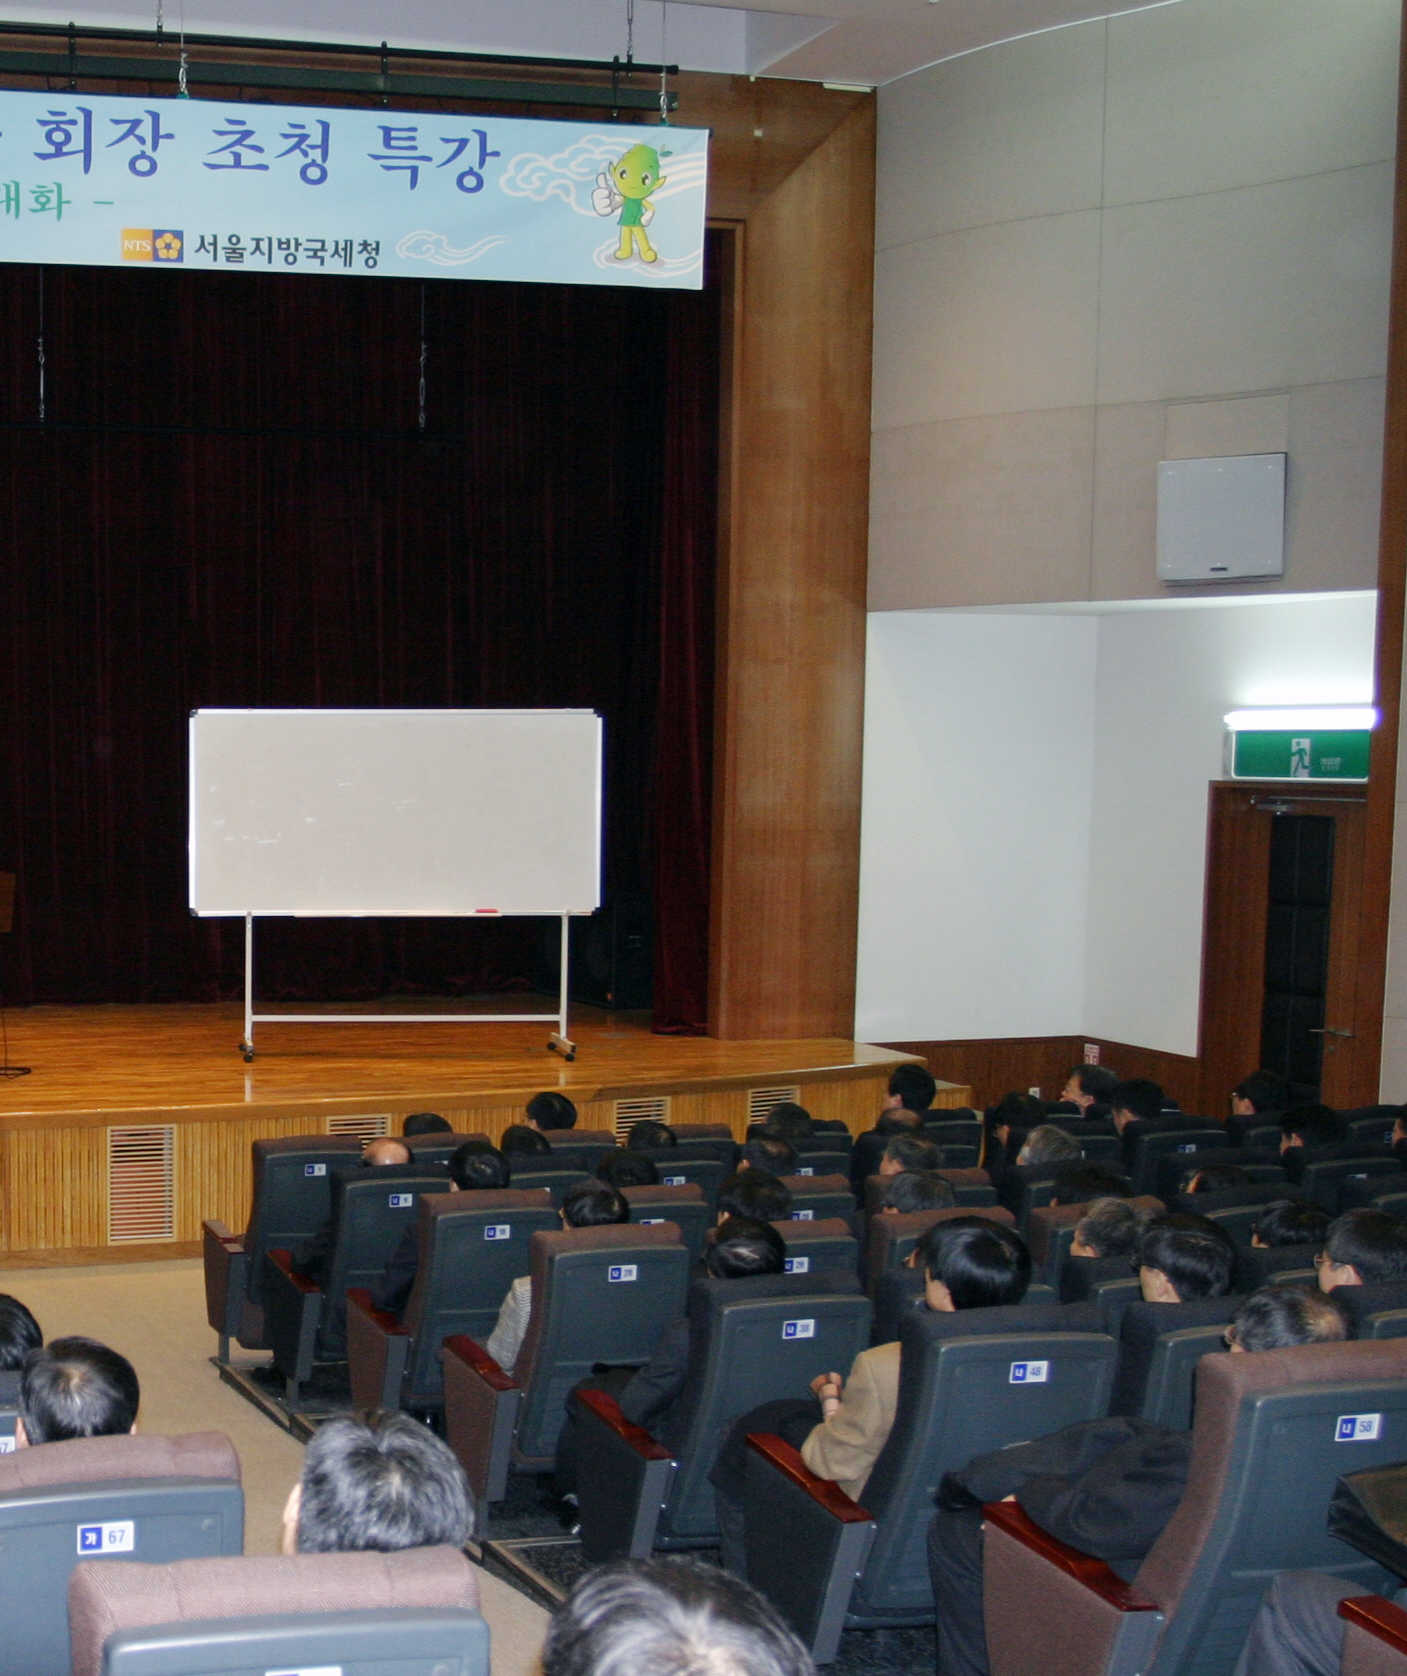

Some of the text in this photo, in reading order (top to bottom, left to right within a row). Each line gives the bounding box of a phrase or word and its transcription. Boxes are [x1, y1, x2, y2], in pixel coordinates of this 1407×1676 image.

[33, 106, 177, 177] 회장
[203, 117, 334, 186] 초청
[370, 126, 501, 195] 특강
[122, 241, 152, 252] NTS
[194, 233, 381, 269] 서울지방국세청
[1014, 1368, 1024, 1378] 나
[1342, 1421, 1372, 1434] 나 58
[84, 1529, 126, 1546] 가 67
